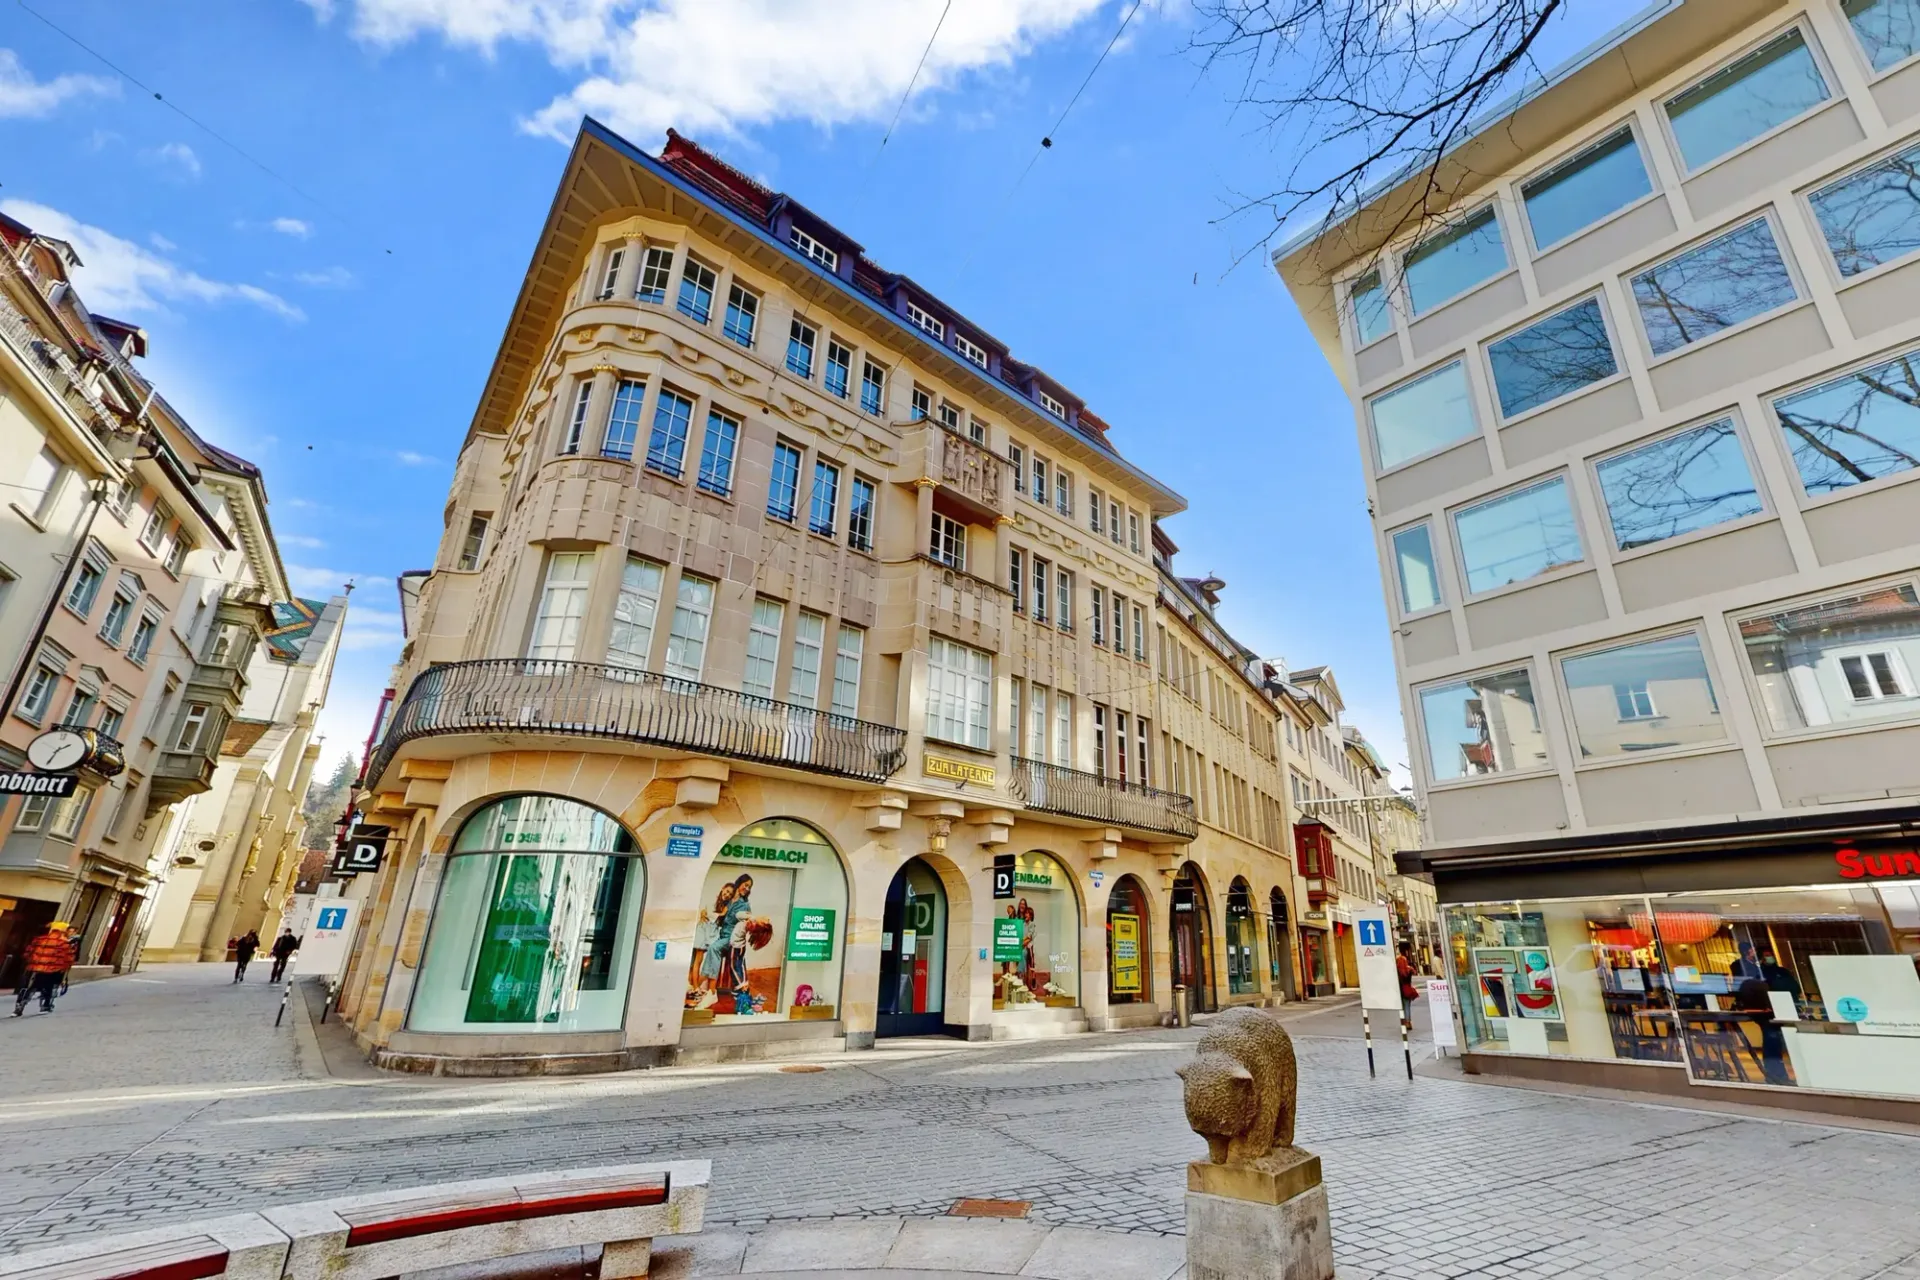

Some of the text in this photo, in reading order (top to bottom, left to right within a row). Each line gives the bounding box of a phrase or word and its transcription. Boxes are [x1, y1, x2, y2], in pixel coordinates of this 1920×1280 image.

[929, 759, 994, 784] ZUR LATERNE
[353, 844, 377, 863] D
[1835, 849, 1920, 879] Sun
[997, 873, 1009, 890] D
[799, 922, 827, 930] ONLINE
[804, 915, 825, 923] SHOP
